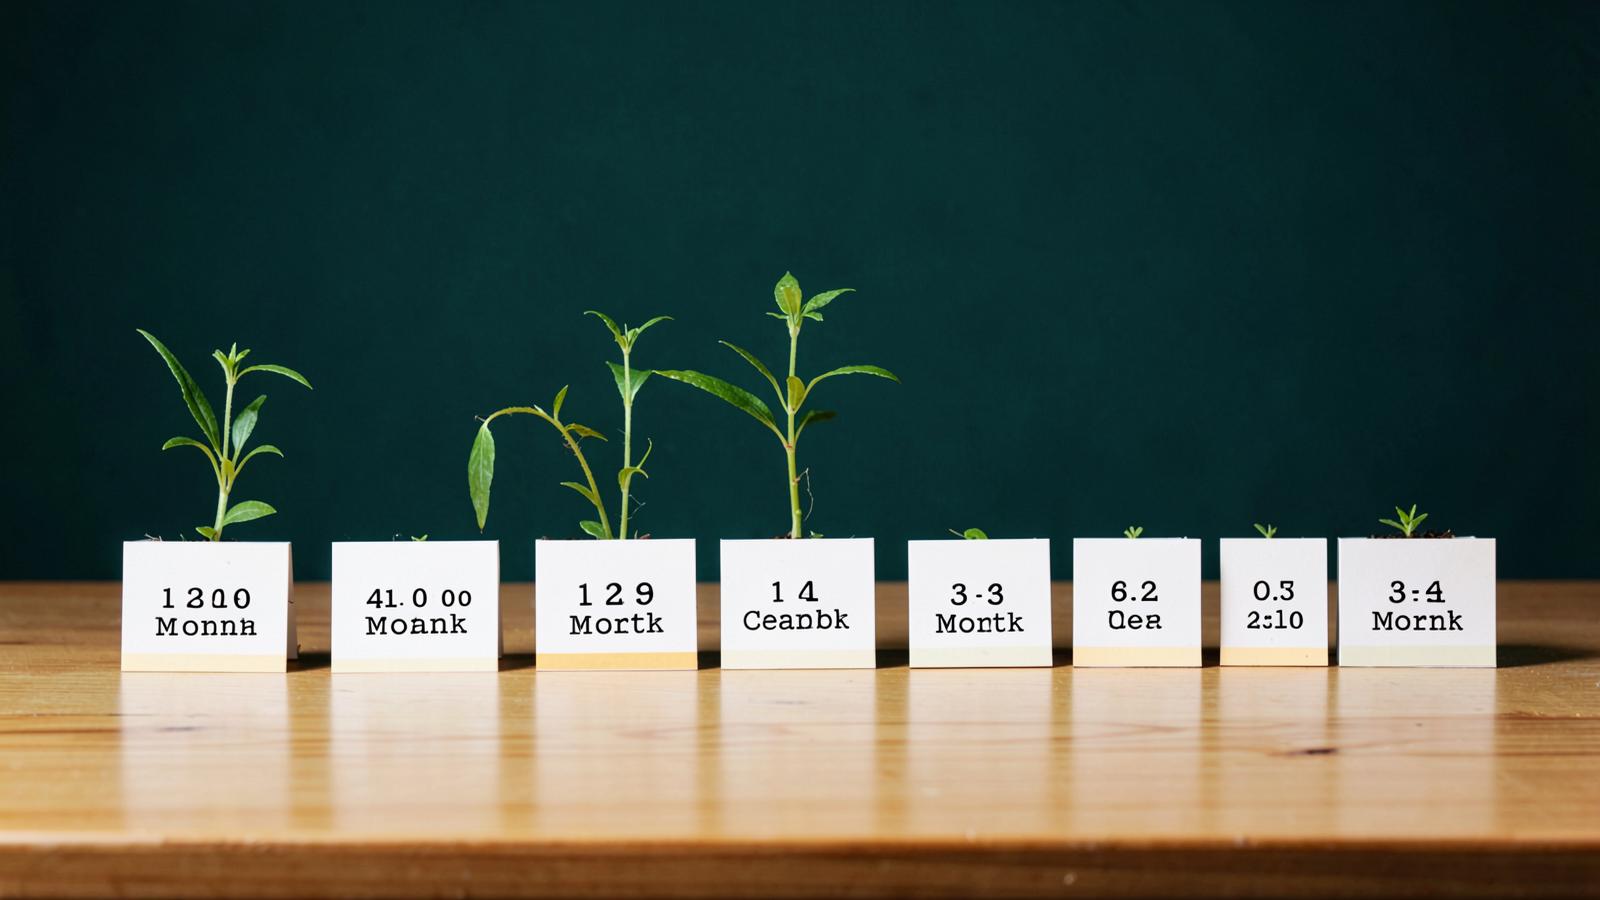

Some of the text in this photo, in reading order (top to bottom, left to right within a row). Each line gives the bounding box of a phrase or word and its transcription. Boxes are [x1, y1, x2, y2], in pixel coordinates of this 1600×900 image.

[1111, 580, 1159, 602] 6.2
[365, 613, 468, 636] Moank
[569, 612, 665, 635] Mortk
[935, 611, 1025, 634] Montk
[1371, 609, 1464, 631] Mornk
